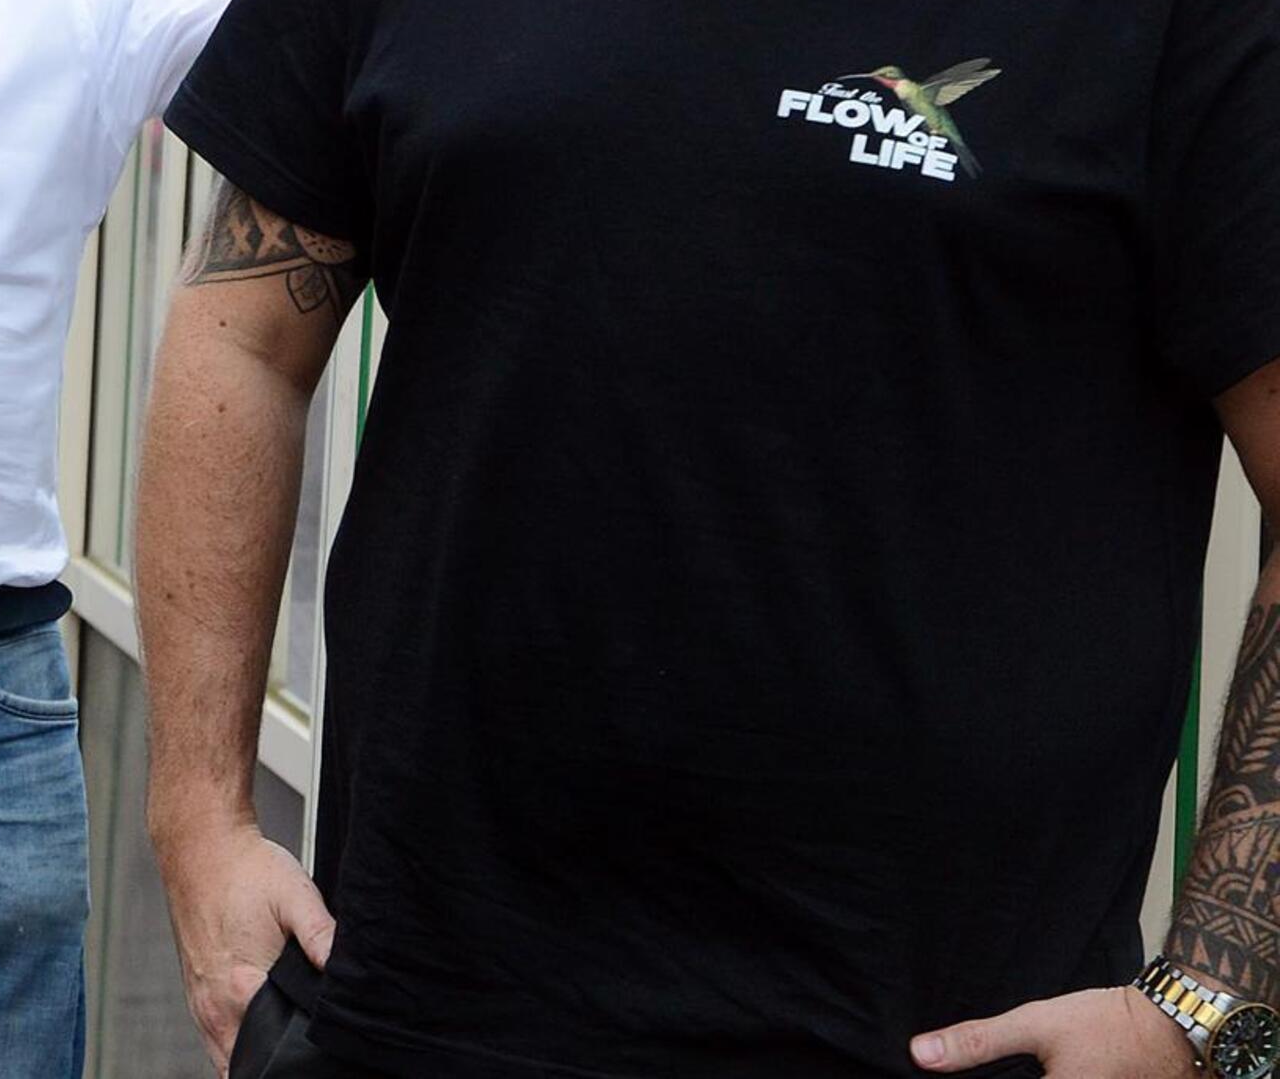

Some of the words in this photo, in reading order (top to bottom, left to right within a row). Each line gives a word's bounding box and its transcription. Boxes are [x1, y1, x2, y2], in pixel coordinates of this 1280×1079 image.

[777, 89, 926, 138] FLOW
[907, 131, 948, 151] OF
[849, 134, 959, 182] LIFE
